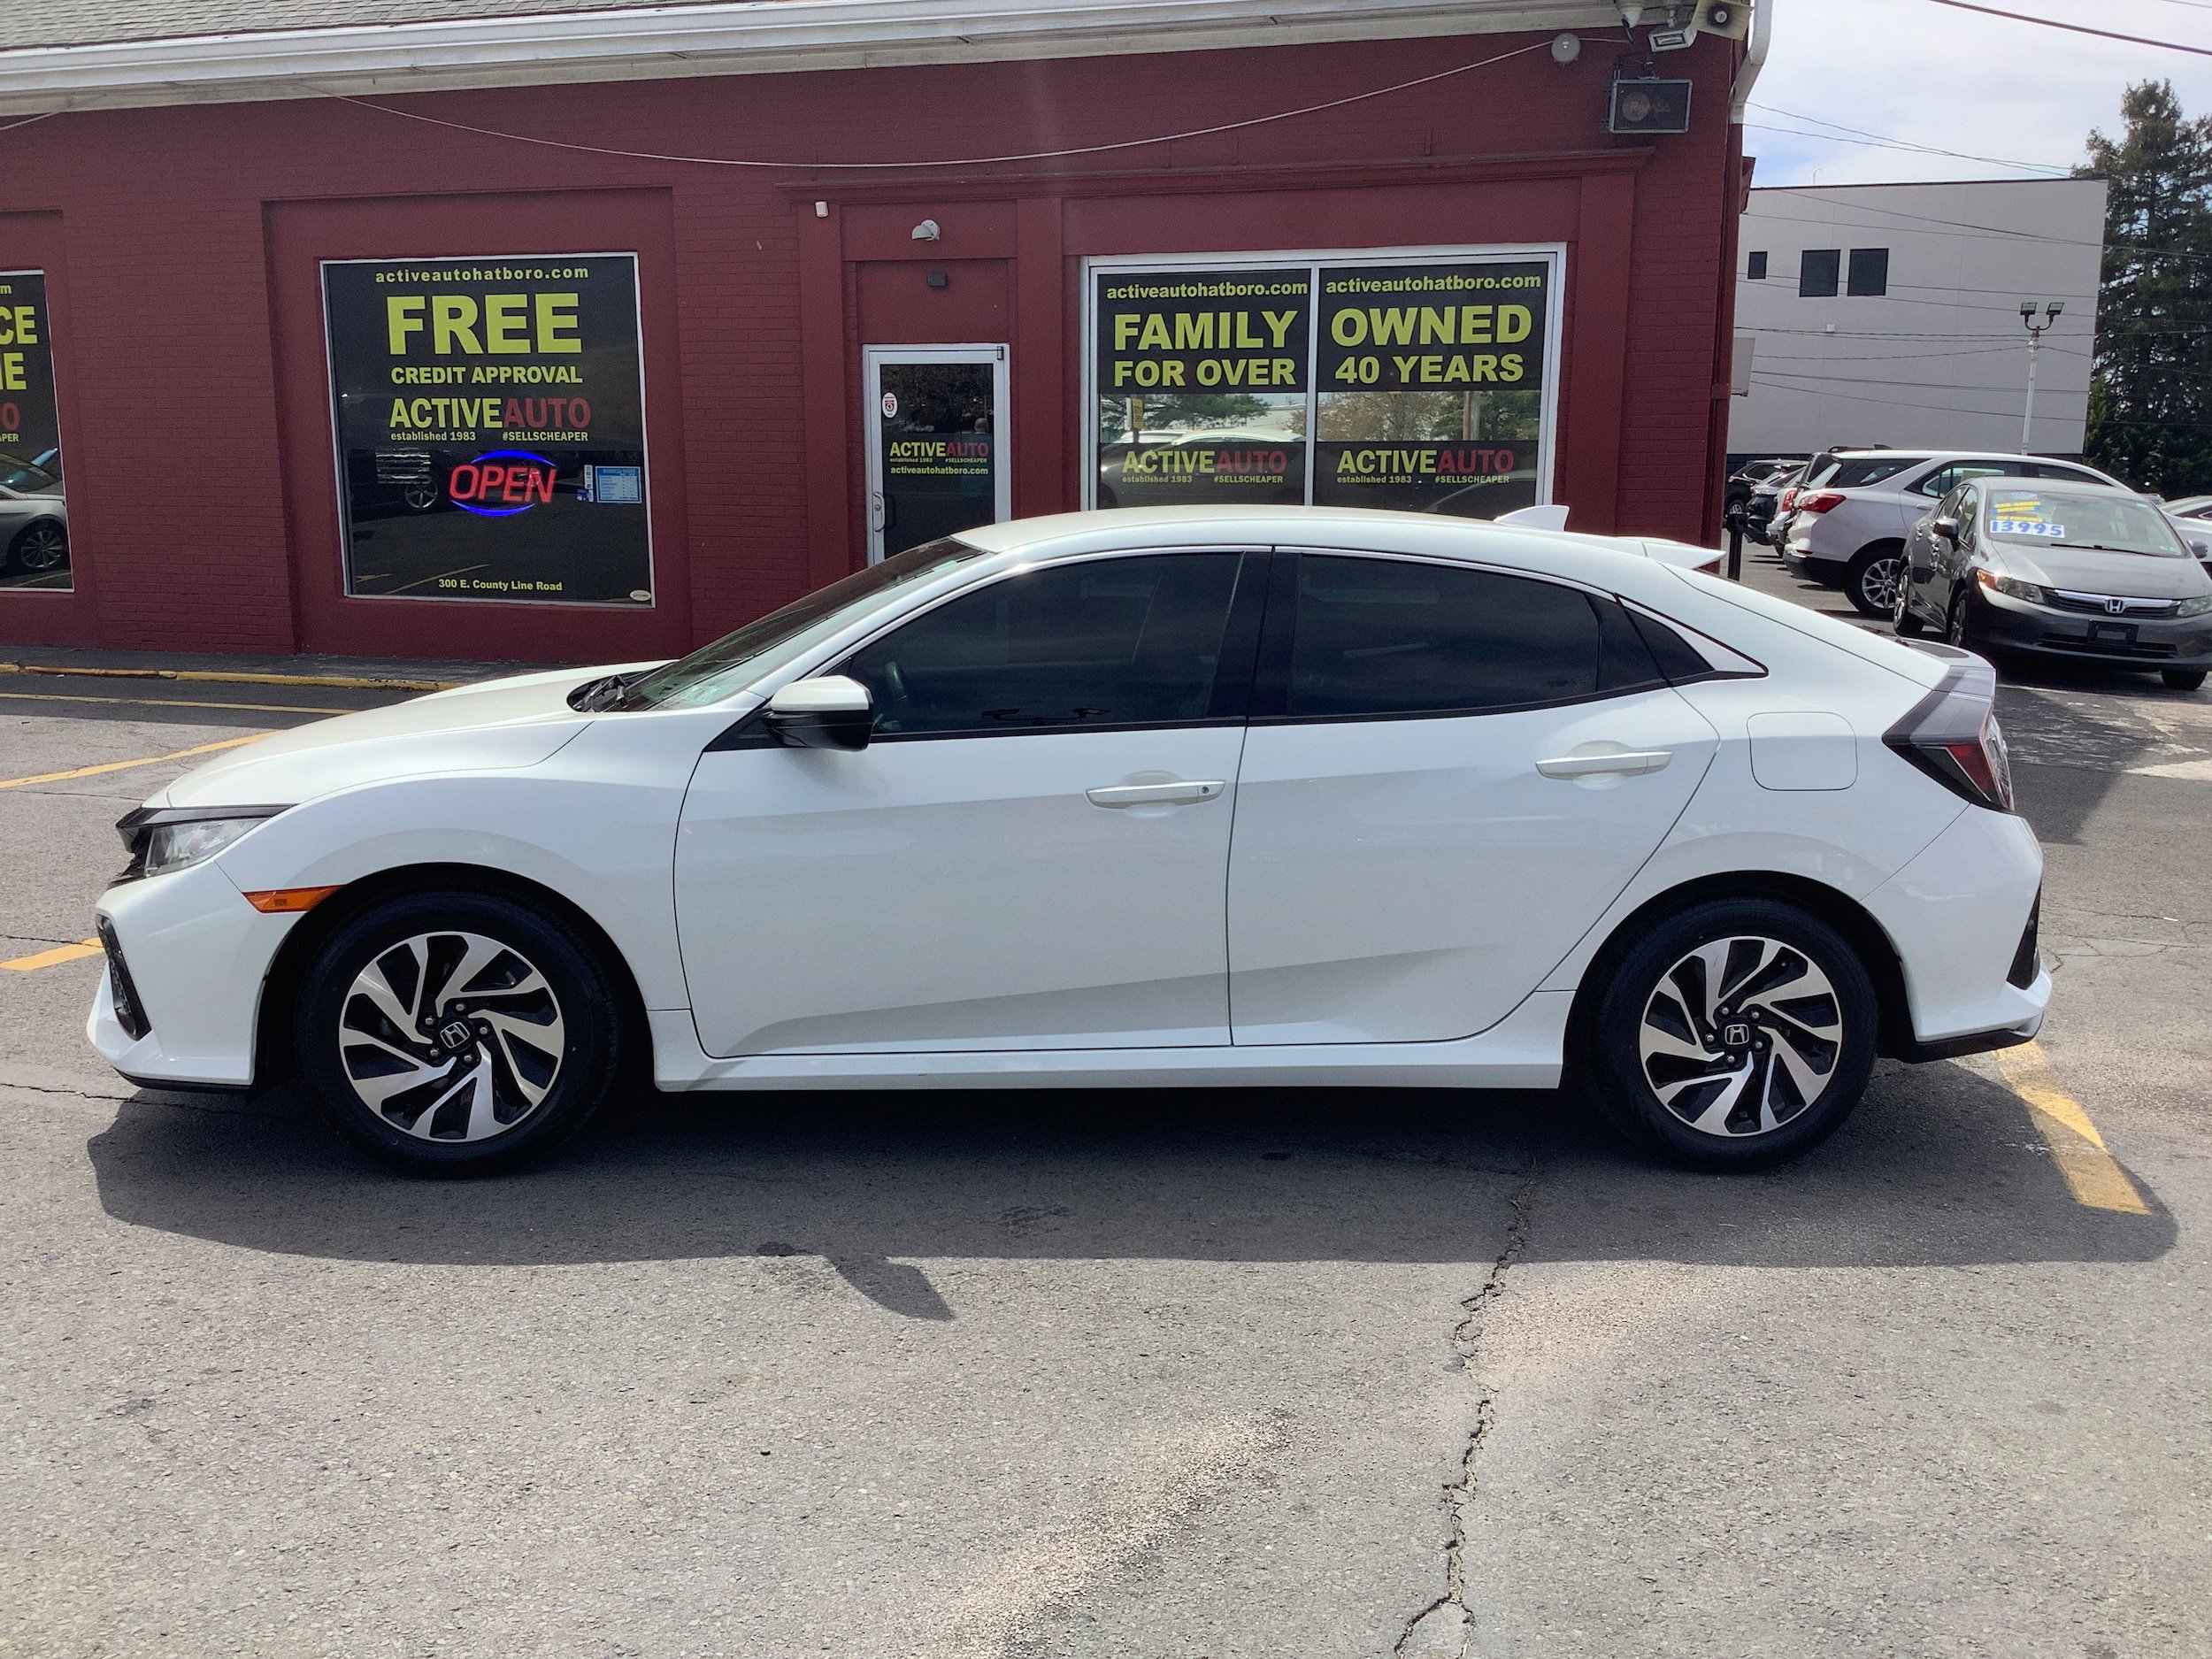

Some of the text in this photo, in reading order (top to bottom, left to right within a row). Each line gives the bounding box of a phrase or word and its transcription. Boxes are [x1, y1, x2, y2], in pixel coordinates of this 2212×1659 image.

[375, 267, 589, 283] activeautohatboro.com
[1107, 281, 1309, 299] activeautohatboro.com
[1326, 275, 1541, 294] activeautohatboro.com
[387, 292, 582, 355] FREE
[1114, 310, 1299, 350] FAMILY
[1331, 303, 1532, 347] OWNED
[390, 366, 583, 384] CREDIT APPROVAL
[1114, 358, 1296, 387] FOR OVER
[1334, 354, 1525, 384] 40 YEARS
[390, 431, 476, 442] established 1983
[502, 431, 588, 442] #SELLSCHEAPER
[890, 465, 989, 475] activeautohatboro.com
[449, 465, 557, 503] OPEN
[1214, 475, 1284, 484] #SELLSCHEAPER
[1336, 475, 1412, 484] established 1983
[1434, 475, 1510, 484] #SELLSCHEAPER
[1992, 521, 2062, 536] 13995
[438, 579, 563, 591] 300 E. County Line Road
